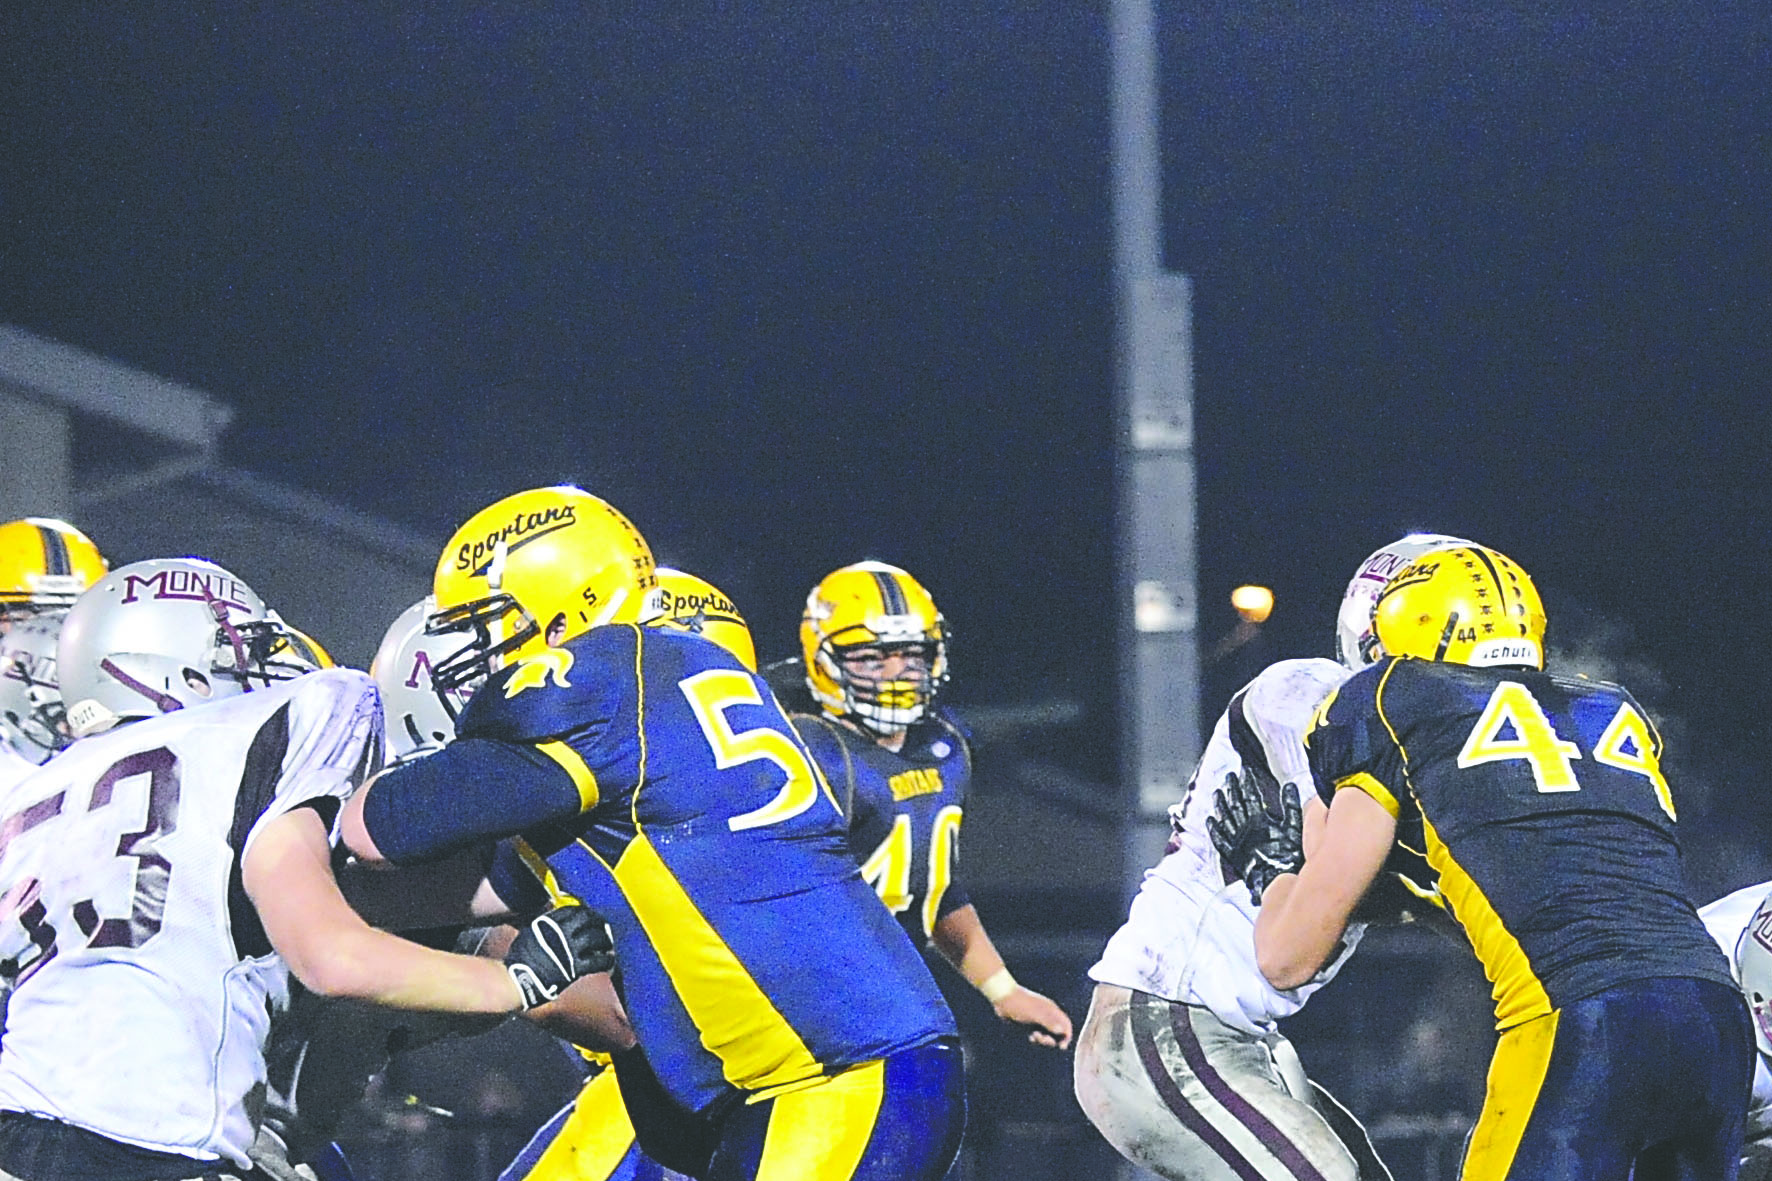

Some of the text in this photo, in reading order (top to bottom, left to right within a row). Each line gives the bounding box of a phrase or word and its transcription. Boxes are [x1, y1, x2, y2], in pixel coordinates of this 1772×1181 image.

[456, 505, 576, 571] Spartans
[121, 570, 250, 606] MONTE
[661, 590, 740, 616] Spartan
[678, 669, 843, 832] 5
[1457, 681, 1677, 823] 44
